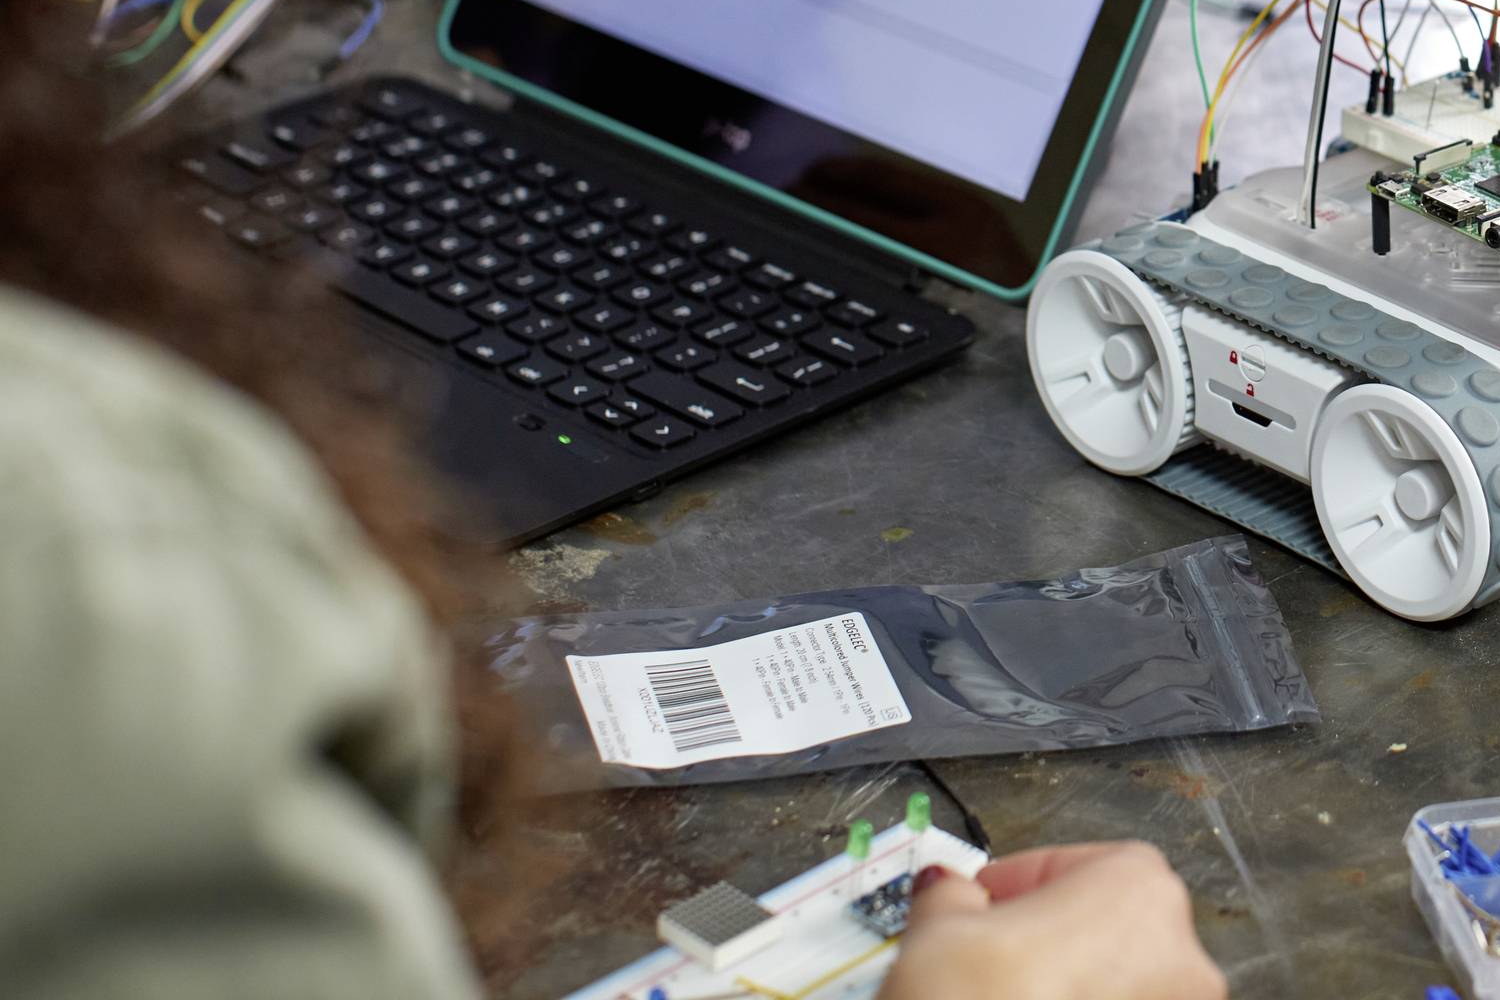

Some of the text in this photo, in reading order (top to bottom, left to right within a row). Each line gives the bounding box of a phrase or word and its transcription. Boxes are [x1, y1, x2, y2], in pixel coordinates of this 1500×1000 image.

[824, 623, 847, 662] Multicolored
[840, 659, 857, 685] Jumper
[850, 682, 864, 700] Wires
